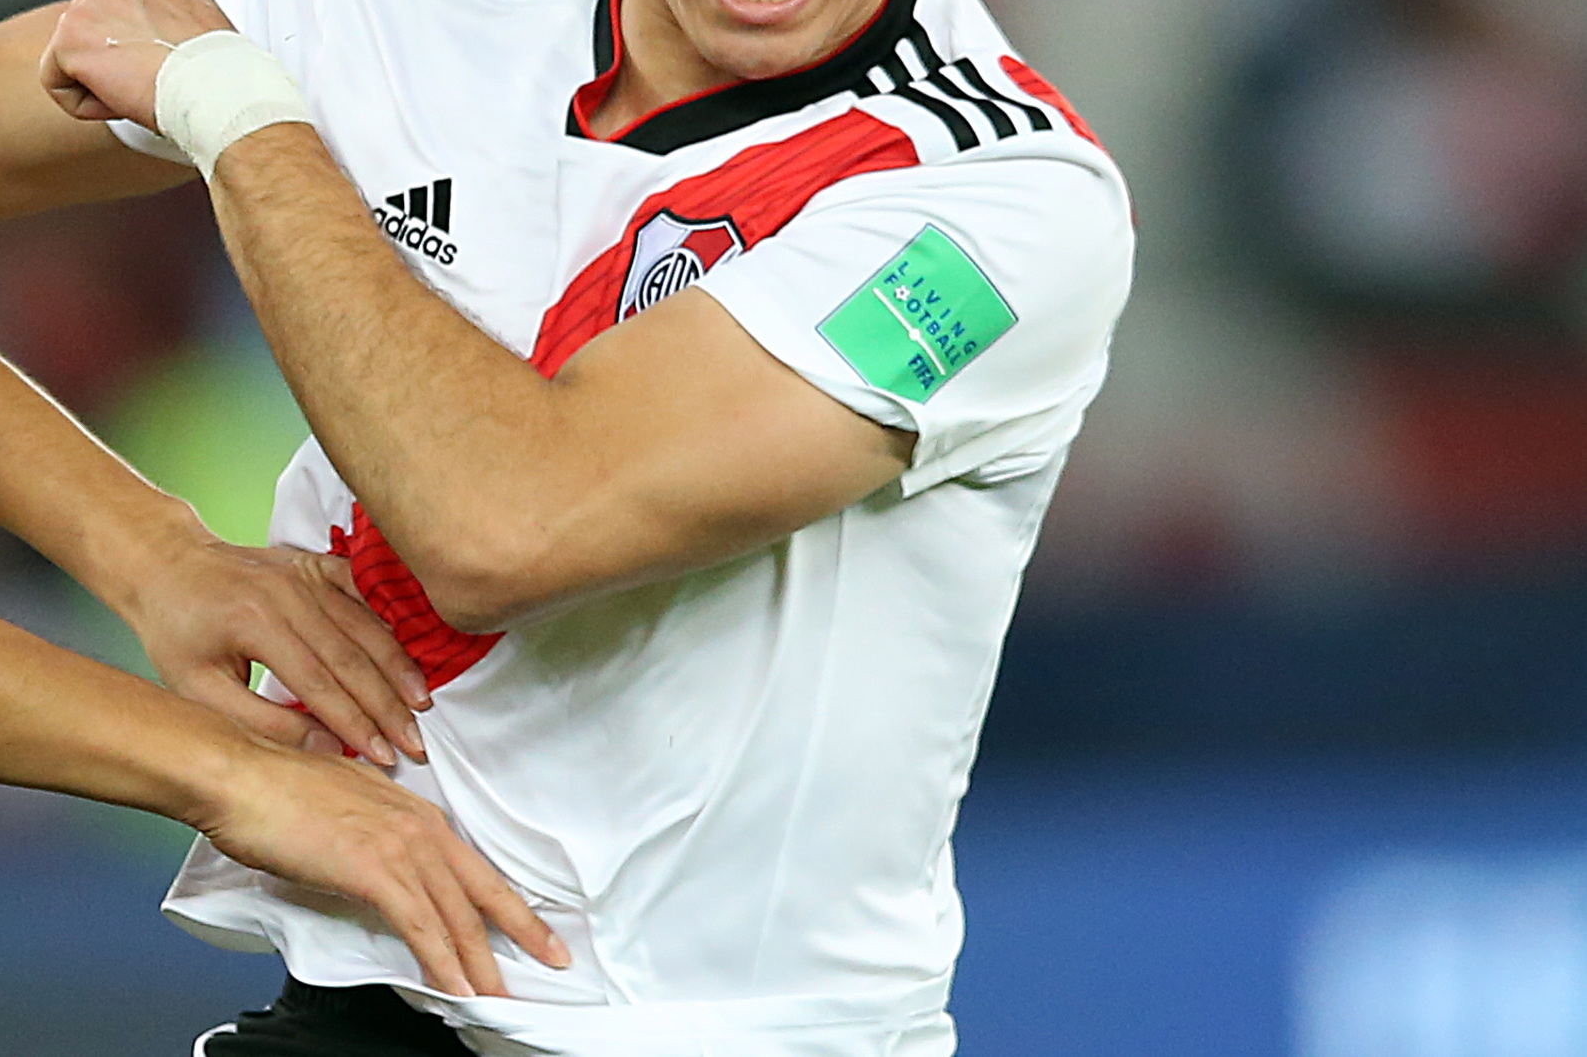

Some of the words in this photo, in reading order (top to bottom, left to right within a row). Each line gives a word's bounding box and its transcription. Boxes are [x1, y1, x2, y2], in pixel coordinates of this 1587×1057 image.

[373, 207, 458, 266] adidas
[897, 260, 978, 355] LIVING
[907, 353, 936, 391] FIFA
